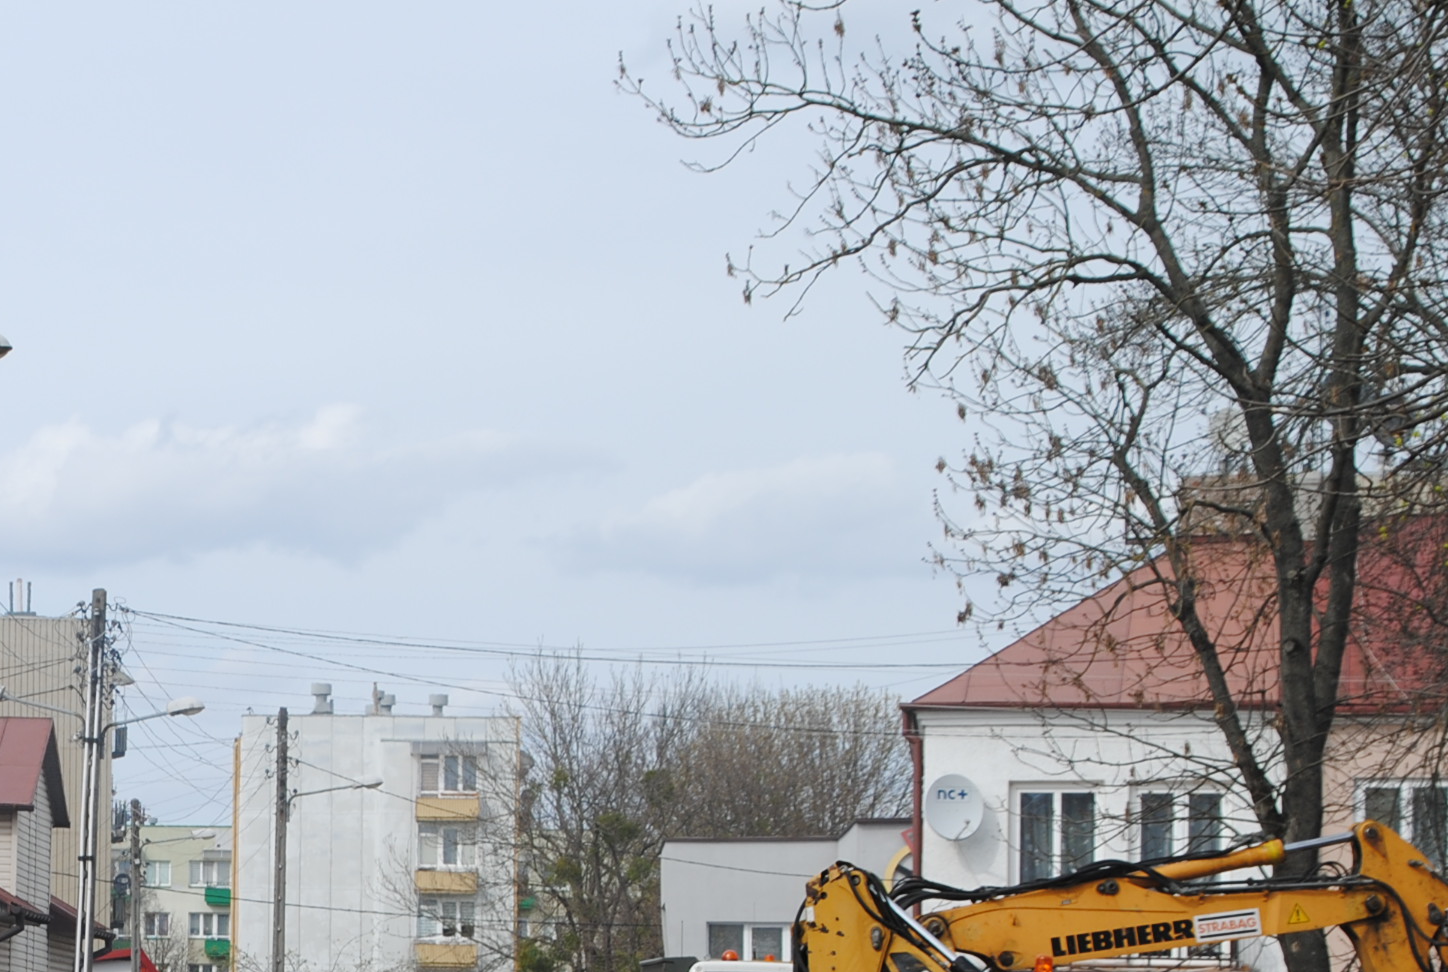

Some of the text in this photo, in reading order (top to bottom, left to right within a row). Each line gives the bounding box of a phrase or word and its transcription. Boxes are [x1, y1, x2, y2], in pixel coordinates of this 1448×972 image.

[937, 789, 968, 800] nc+
[1197, 916, 1257, 935] STRABAG
[1050, 919, 1195, 957] LIEBHERR
